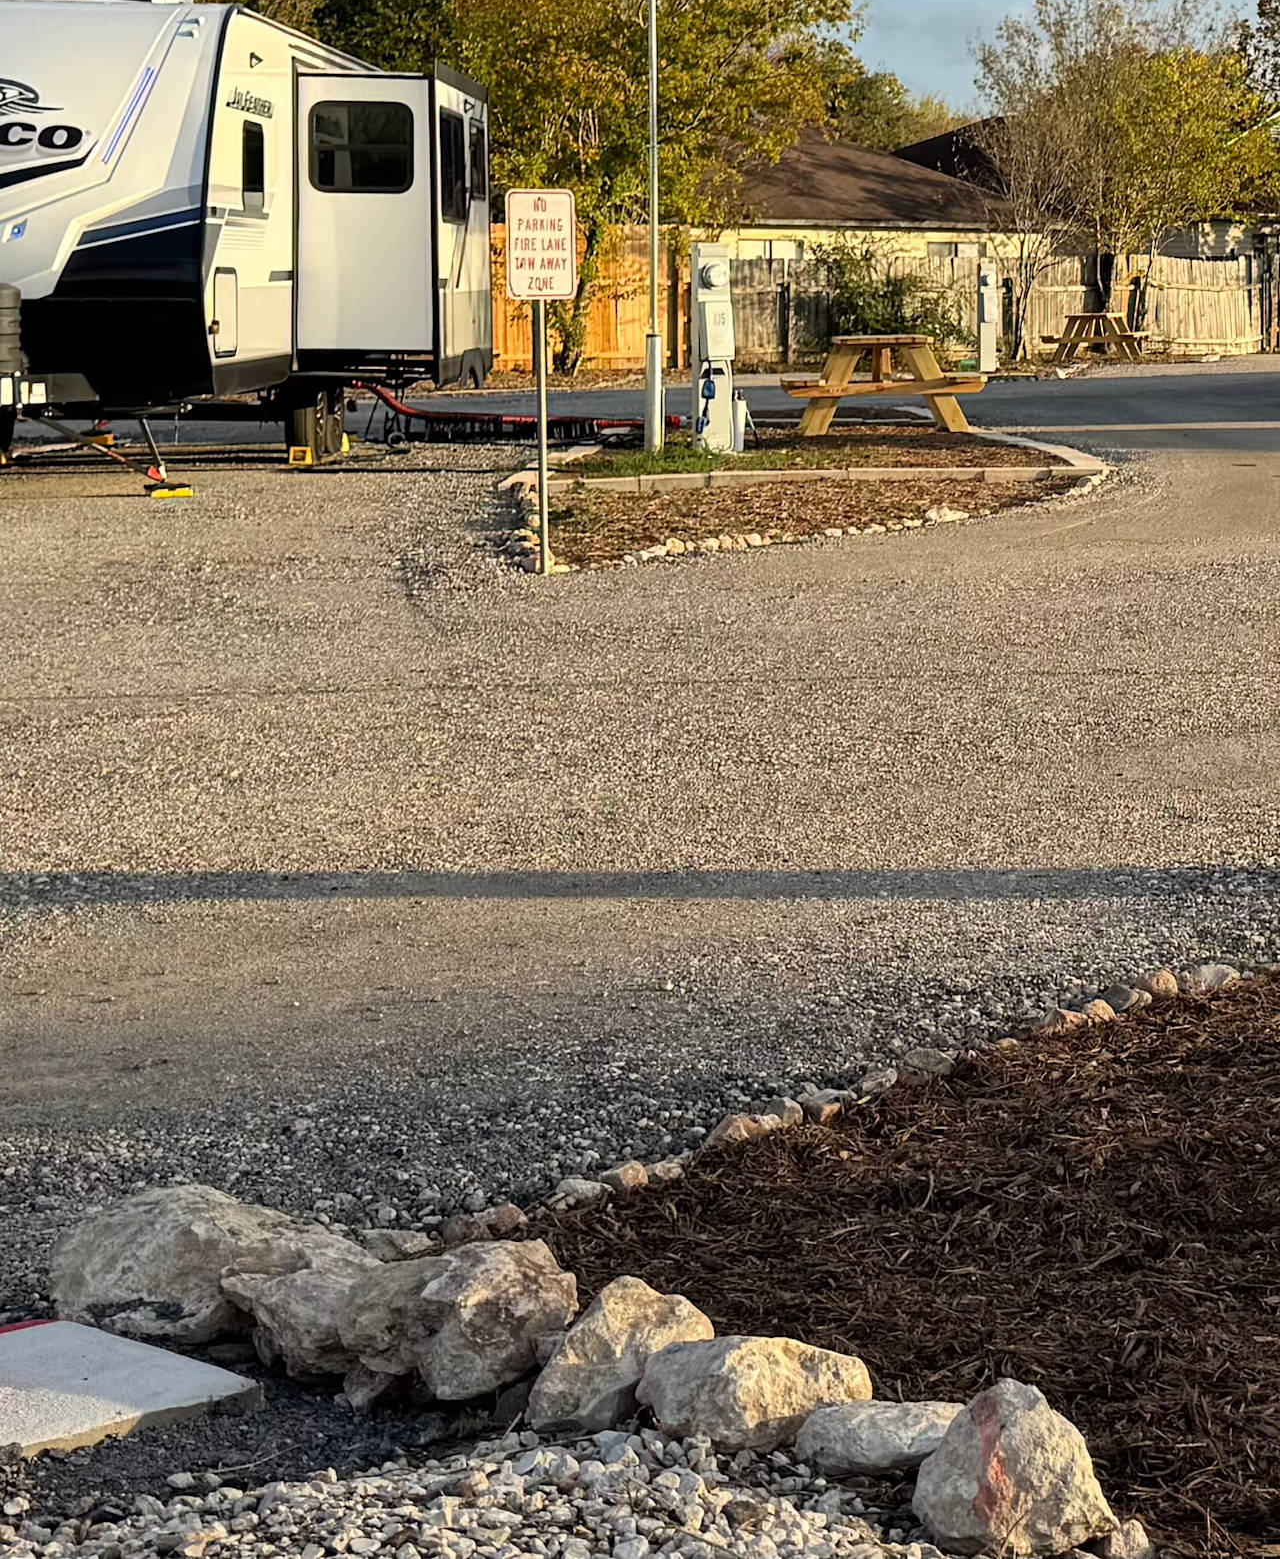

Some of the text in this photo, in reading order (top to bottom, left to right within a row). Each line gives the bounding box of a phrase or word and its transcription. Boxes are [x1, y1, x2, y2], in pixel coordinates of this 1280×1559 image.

[533, 198, 547, 212] NO
[518, 218, 563, 232] PARKING
[515, 238, 567, 251] FIRE LANE
[515, 257, 567, 270] TOW AWAY
[528, 277, 554, 290] ZONE
